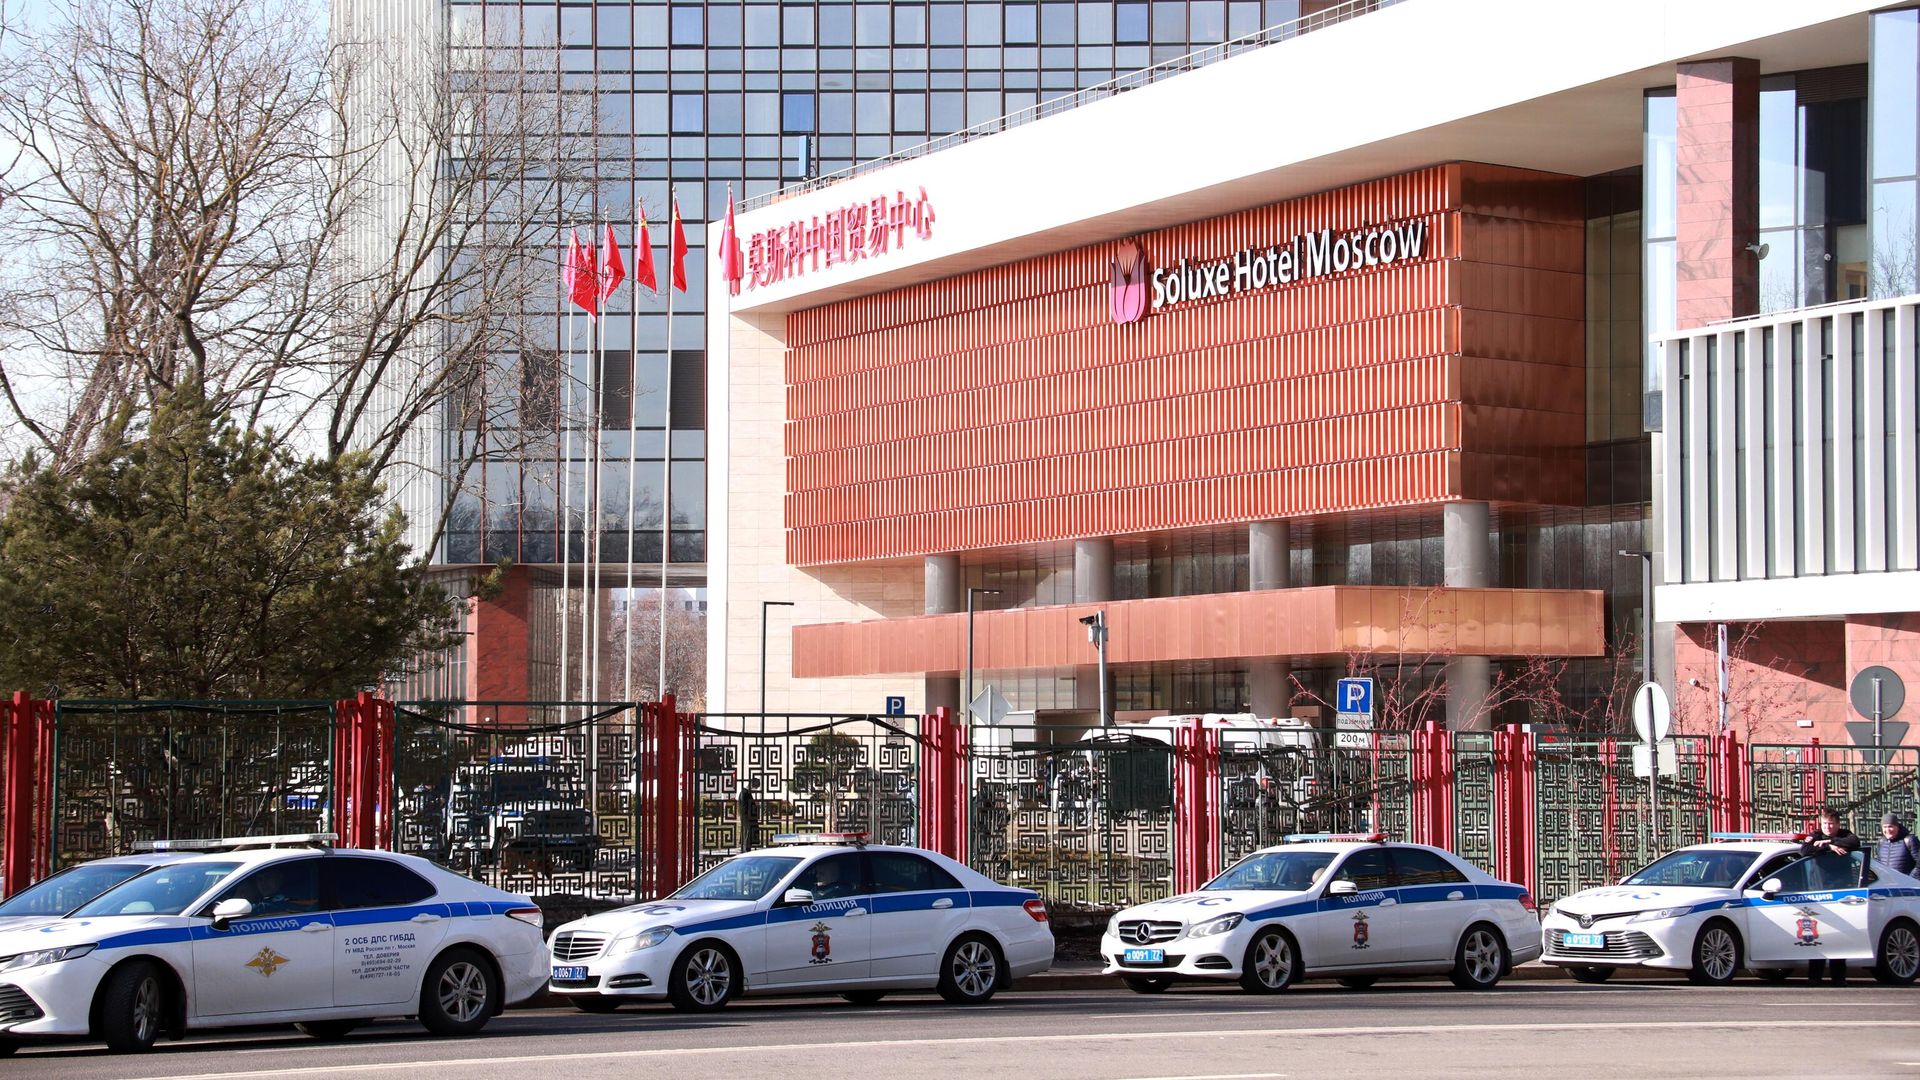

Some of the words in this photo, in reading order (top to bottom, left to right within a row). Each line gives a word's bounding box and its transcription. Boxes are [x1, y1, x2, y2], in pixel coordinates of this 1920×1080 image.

[1152, 257, 1230, 309] Soluxe
[1234, 235, 1300, 293] Hotel
[1306, 221, 1426, 279] Moscow
[1346, 684, 1366, 710] P
[891, 698, 902, 715] P
[1343, 891, 1386, 904] ПОЛИЦИЯ
[1783, 893, 1833, 902] ПОЛИЦИЯ
[801, 900, 858, 914] ПОЛИЦИЯ
[230, 919, 300, 934] ПОЛИЦИЯ
[344, 938, 350, 946] 2
[352, 937, 368, 945] ОСБ
[371, 935, 388, 944] ДПС
[389, 933, 416, 942] ГИБДД
